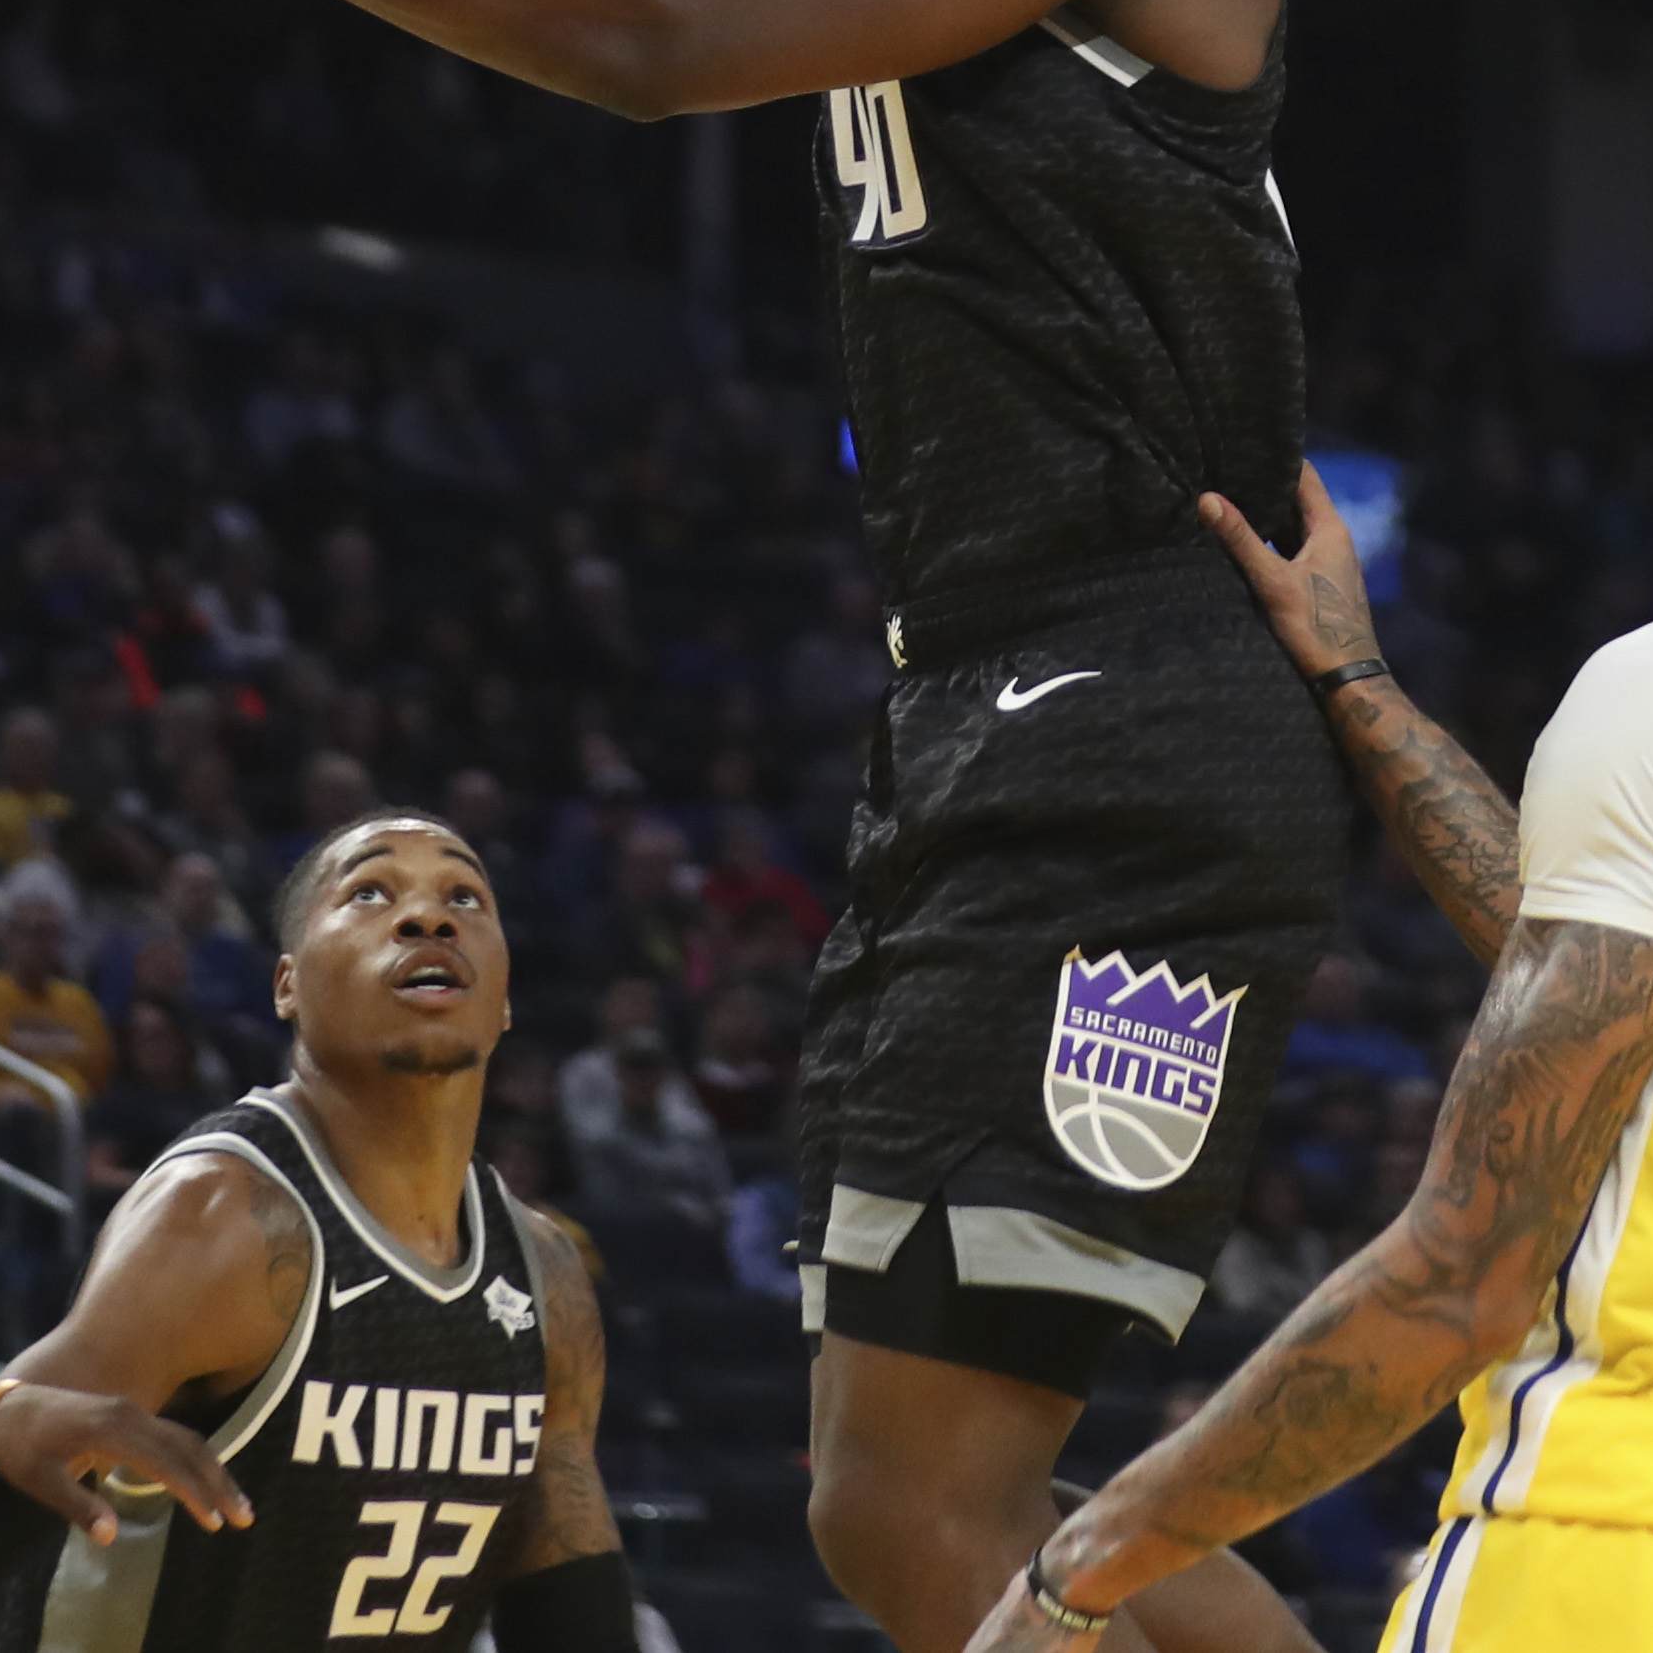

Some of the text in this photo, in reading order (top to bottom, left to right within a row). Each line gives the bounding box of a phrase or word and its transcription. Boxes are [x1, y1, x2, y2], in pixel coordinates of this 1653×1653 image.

[1053, 1032, 1218, 1117] KINGS
[1069, 1005, 1219, 1066] SACRAMENTO
[291, 1379, 545, 1477] KINGS
[328, 1499, 502, 1639] 22
